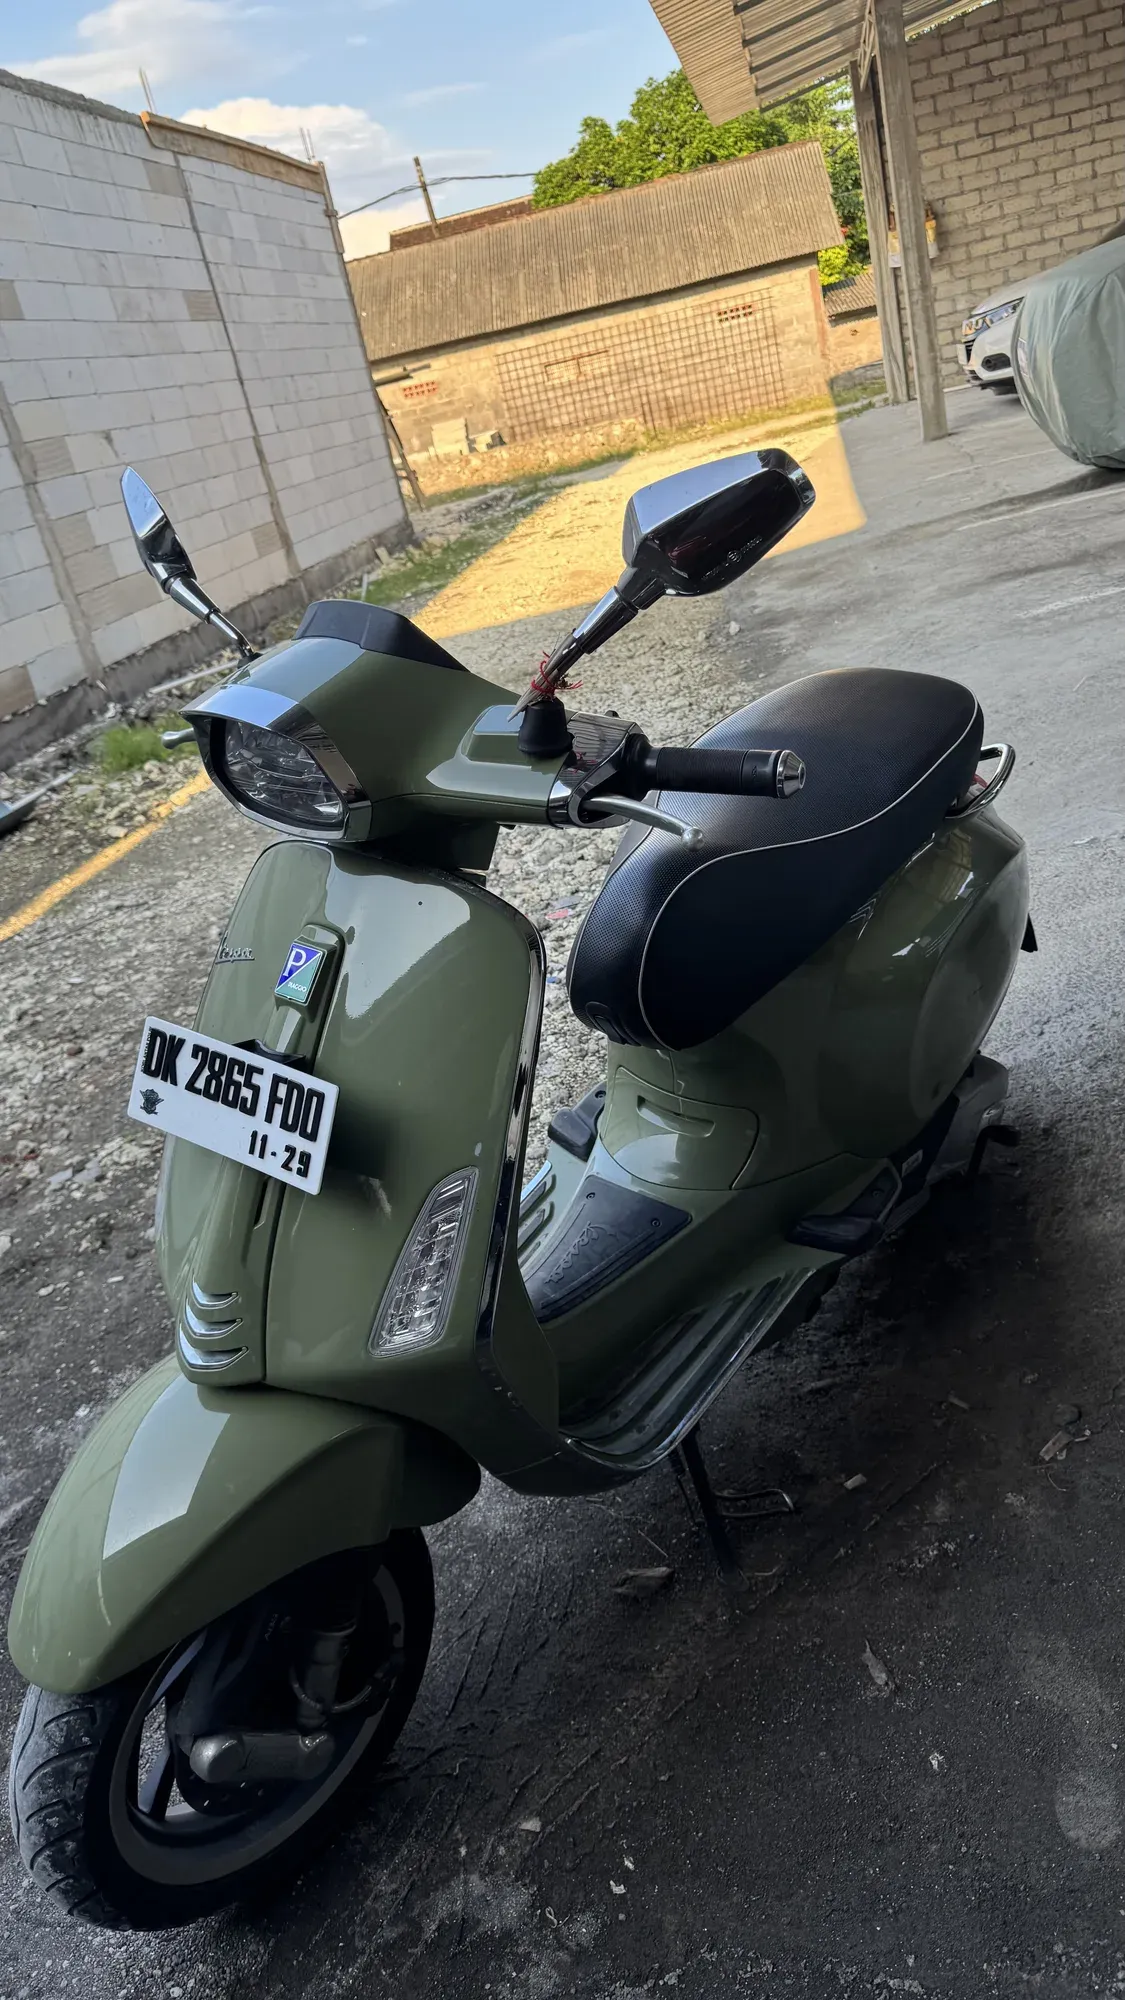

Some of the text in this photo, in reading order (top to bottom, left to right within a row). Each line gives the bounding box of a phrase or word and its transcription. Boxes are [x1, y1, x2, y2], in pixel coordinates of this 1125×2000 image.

[283, 947, 307, 977] P
[287, 981, 307, 993] PIAGGIO
[143, 1028, 326, 1142] DK 2865 FDO
